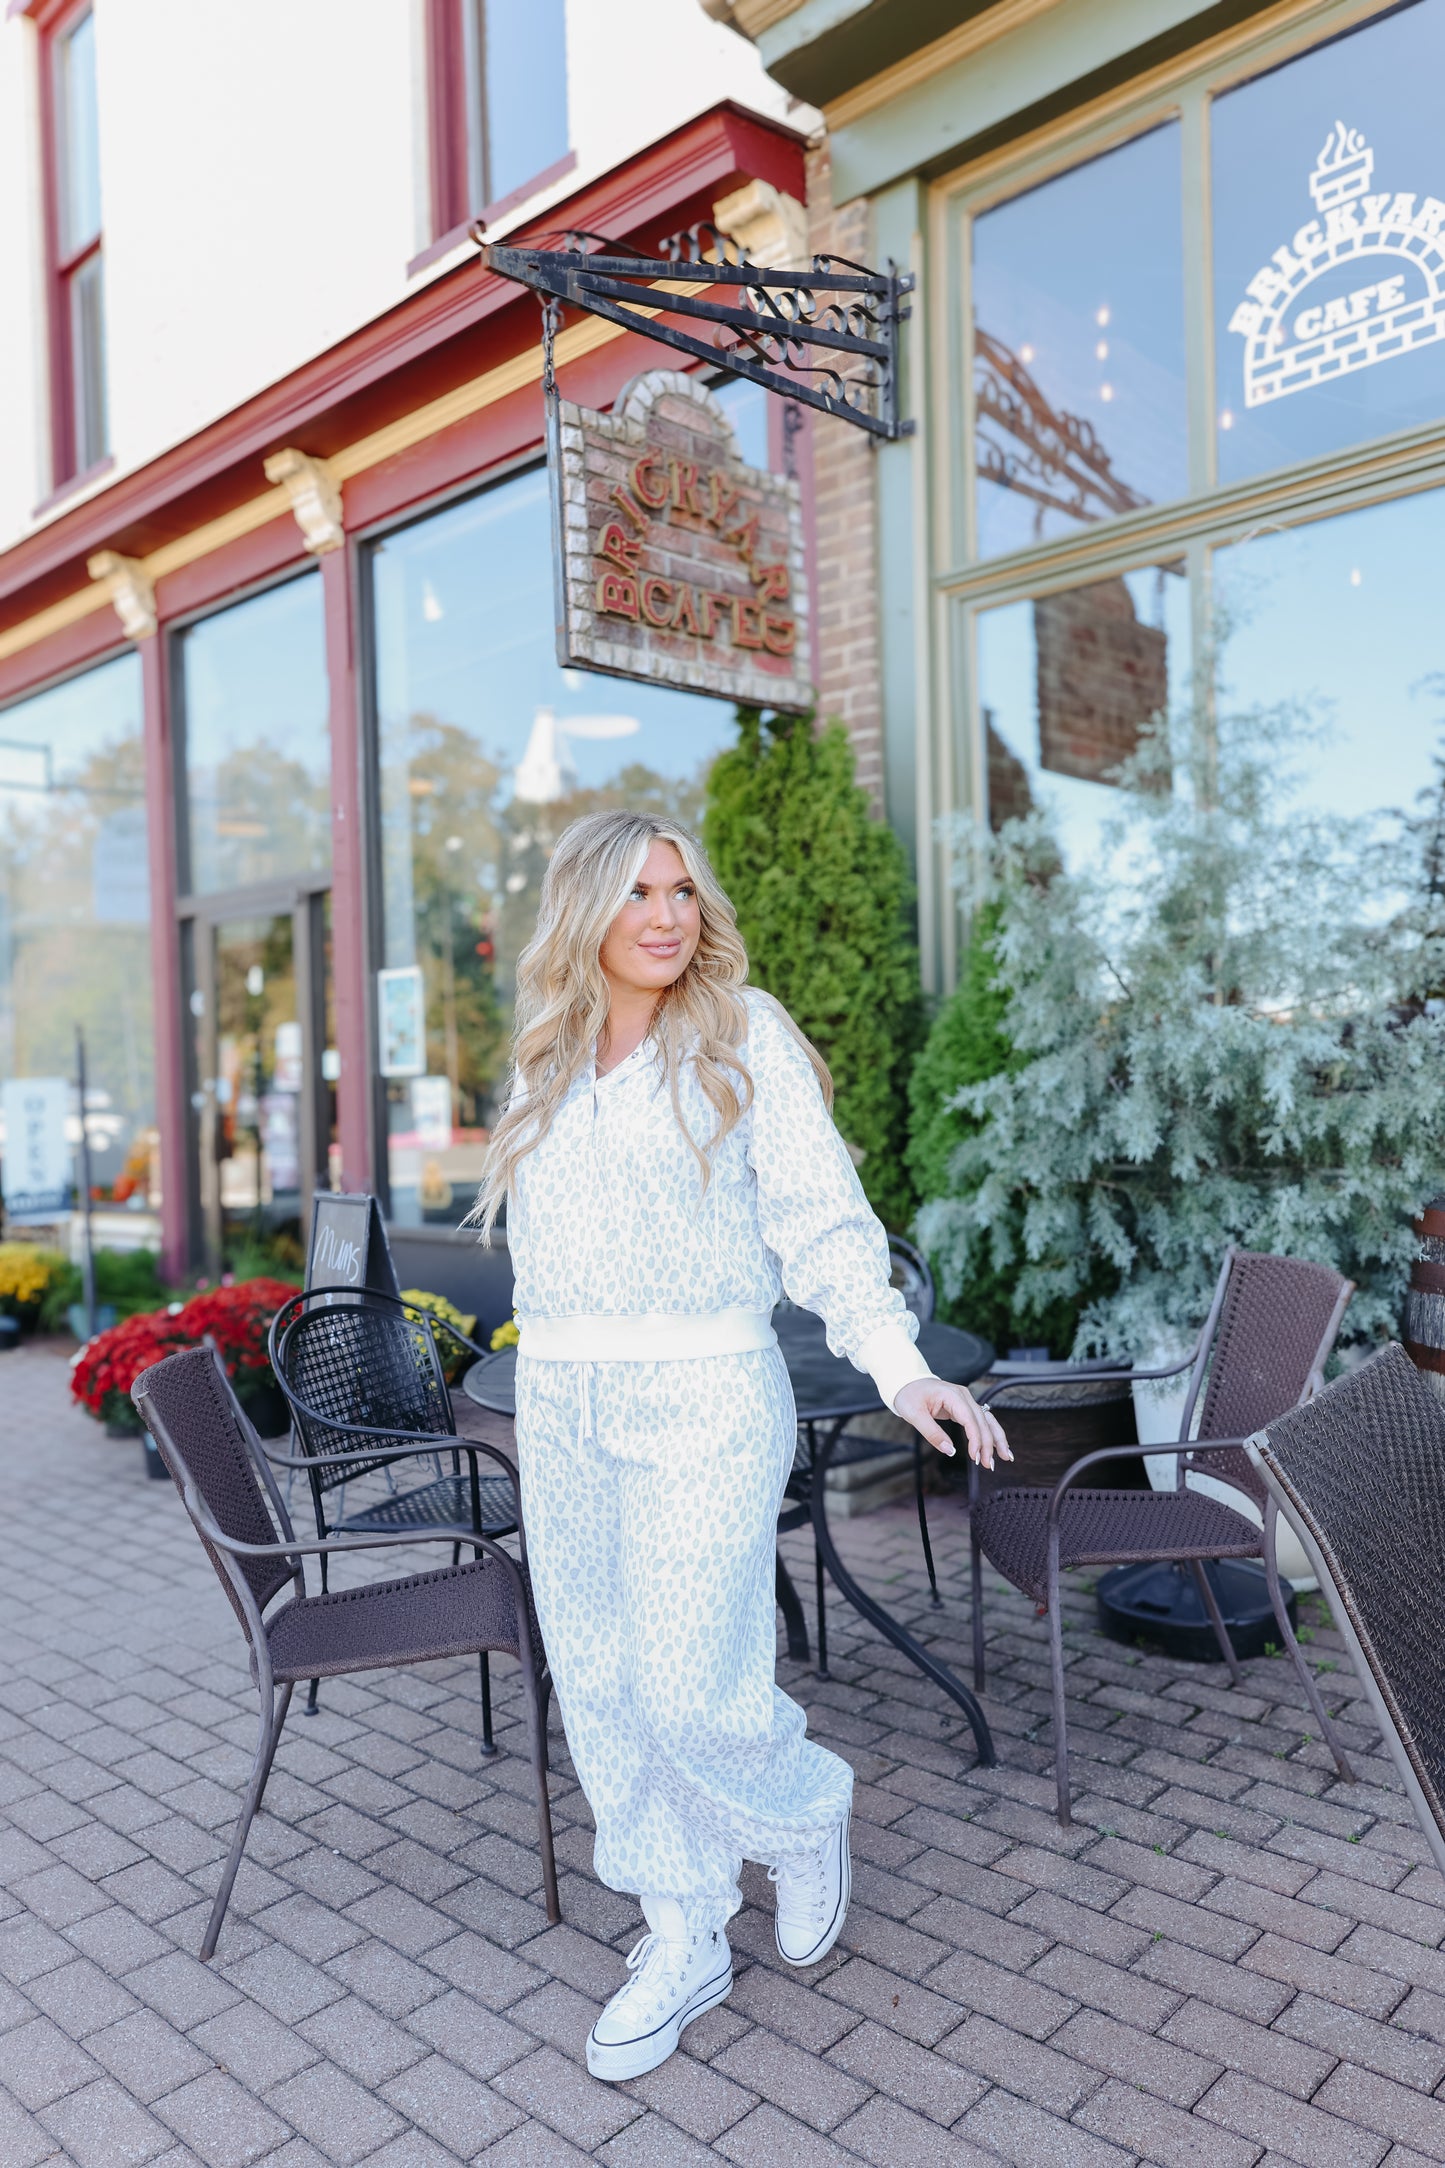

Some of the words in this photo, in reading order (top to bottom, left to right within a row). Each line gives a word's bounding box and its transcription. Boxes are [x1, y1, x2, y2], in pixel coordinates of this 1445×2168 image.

[1228, 193, 1445, 337] BRICKYAR
[1294, 274, 1406, 340] CAFE
[597, 447, 797, 655] BRICKYARD
[639, 578, 763, 648] CAFE
